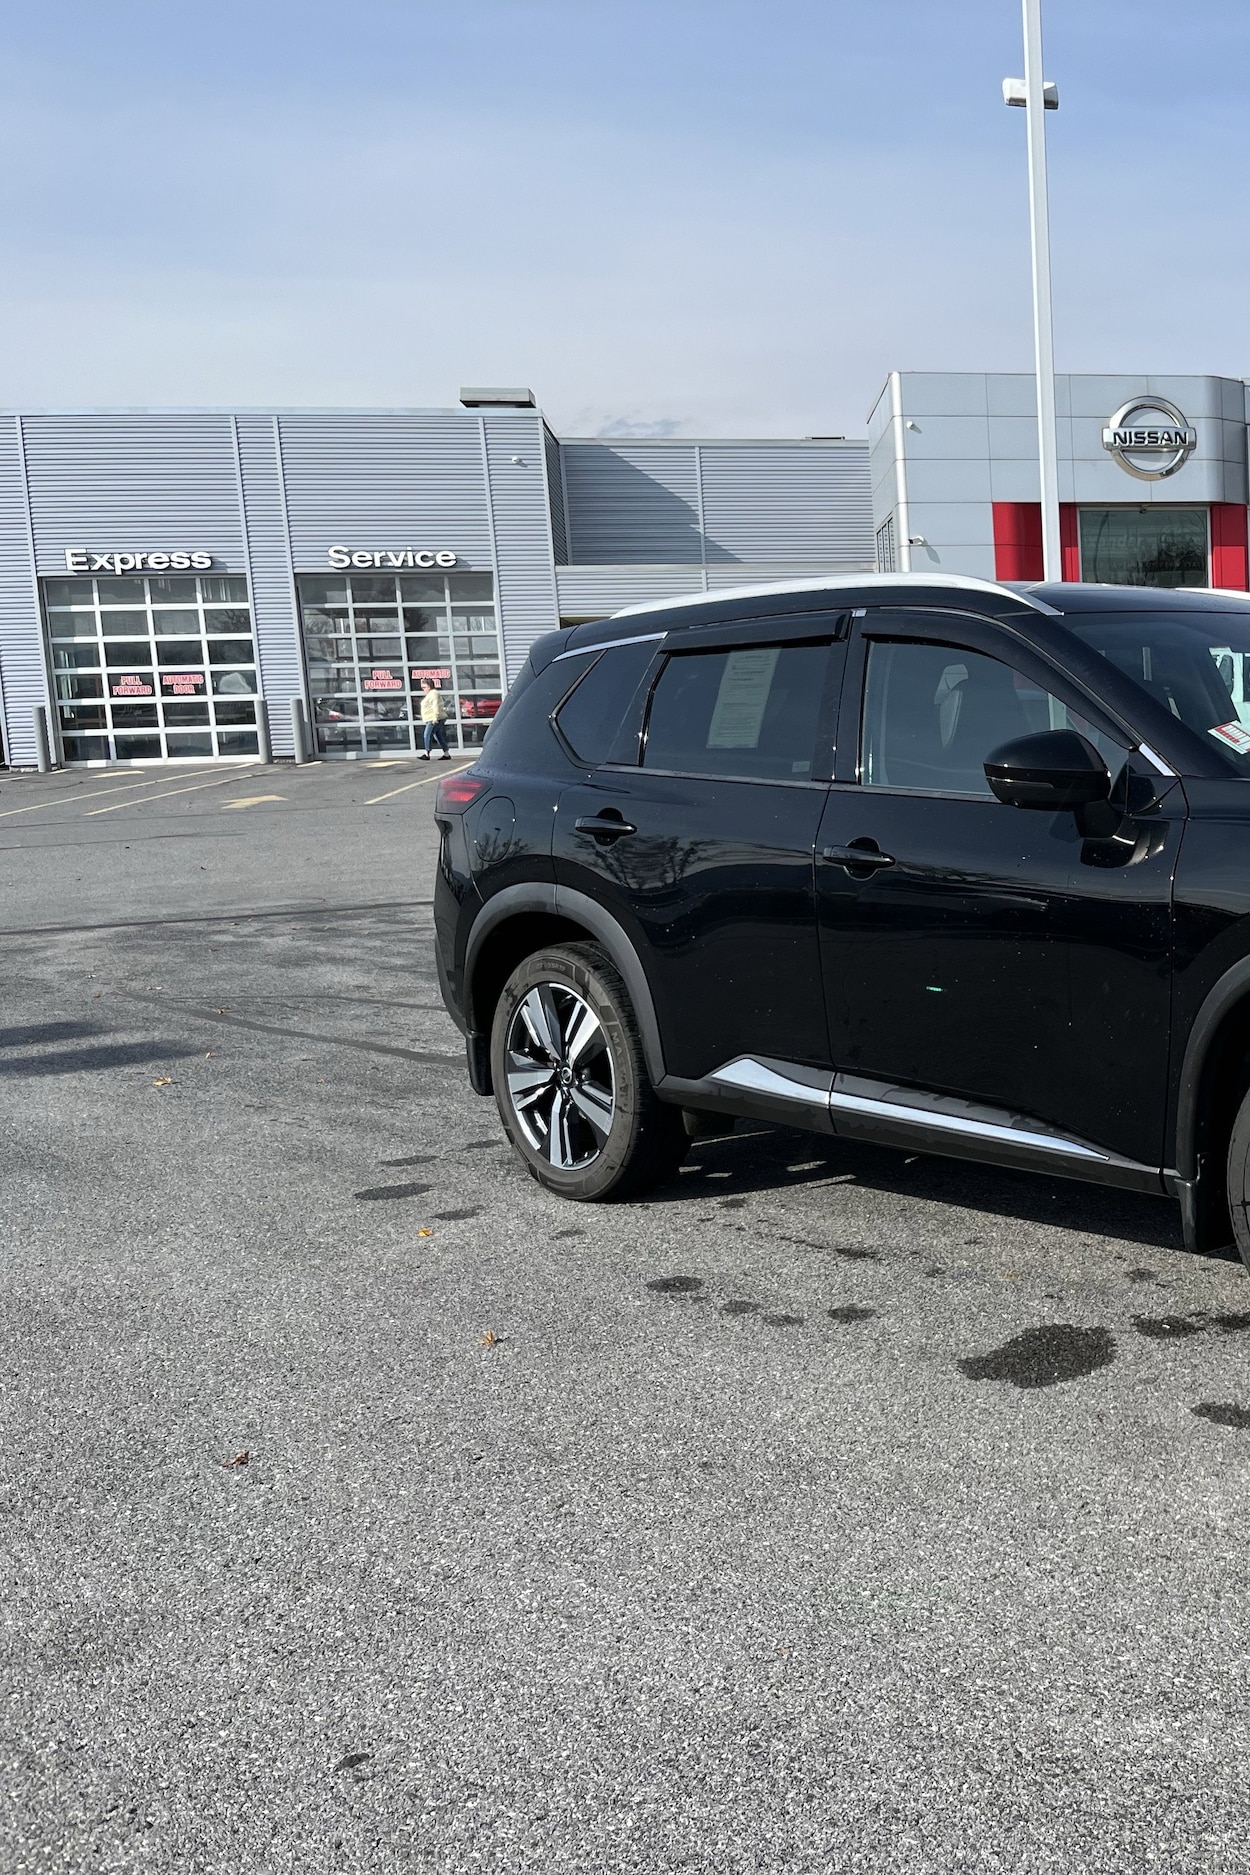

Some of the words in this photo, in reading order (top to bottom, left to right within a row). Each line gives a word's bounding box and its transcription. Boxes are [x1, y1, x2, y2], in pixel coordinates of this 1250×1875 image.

[1113, 430, 1187, 446] NISSAN
[64, 548, 213, 576] Express
[327, 545, 458, 569] Service
[371, 669, 394, 680] PULL
[411, 668, 451, 679] AUTOMATIC
[120, 675, 143, 686] PULL
[162, 674, 205, 685] AUTOMATIC
[364, 679, 403, 690] FORWARD
[112, 685, 153, 696] FORWARD
[172, 684, 196, 695] DOOR
